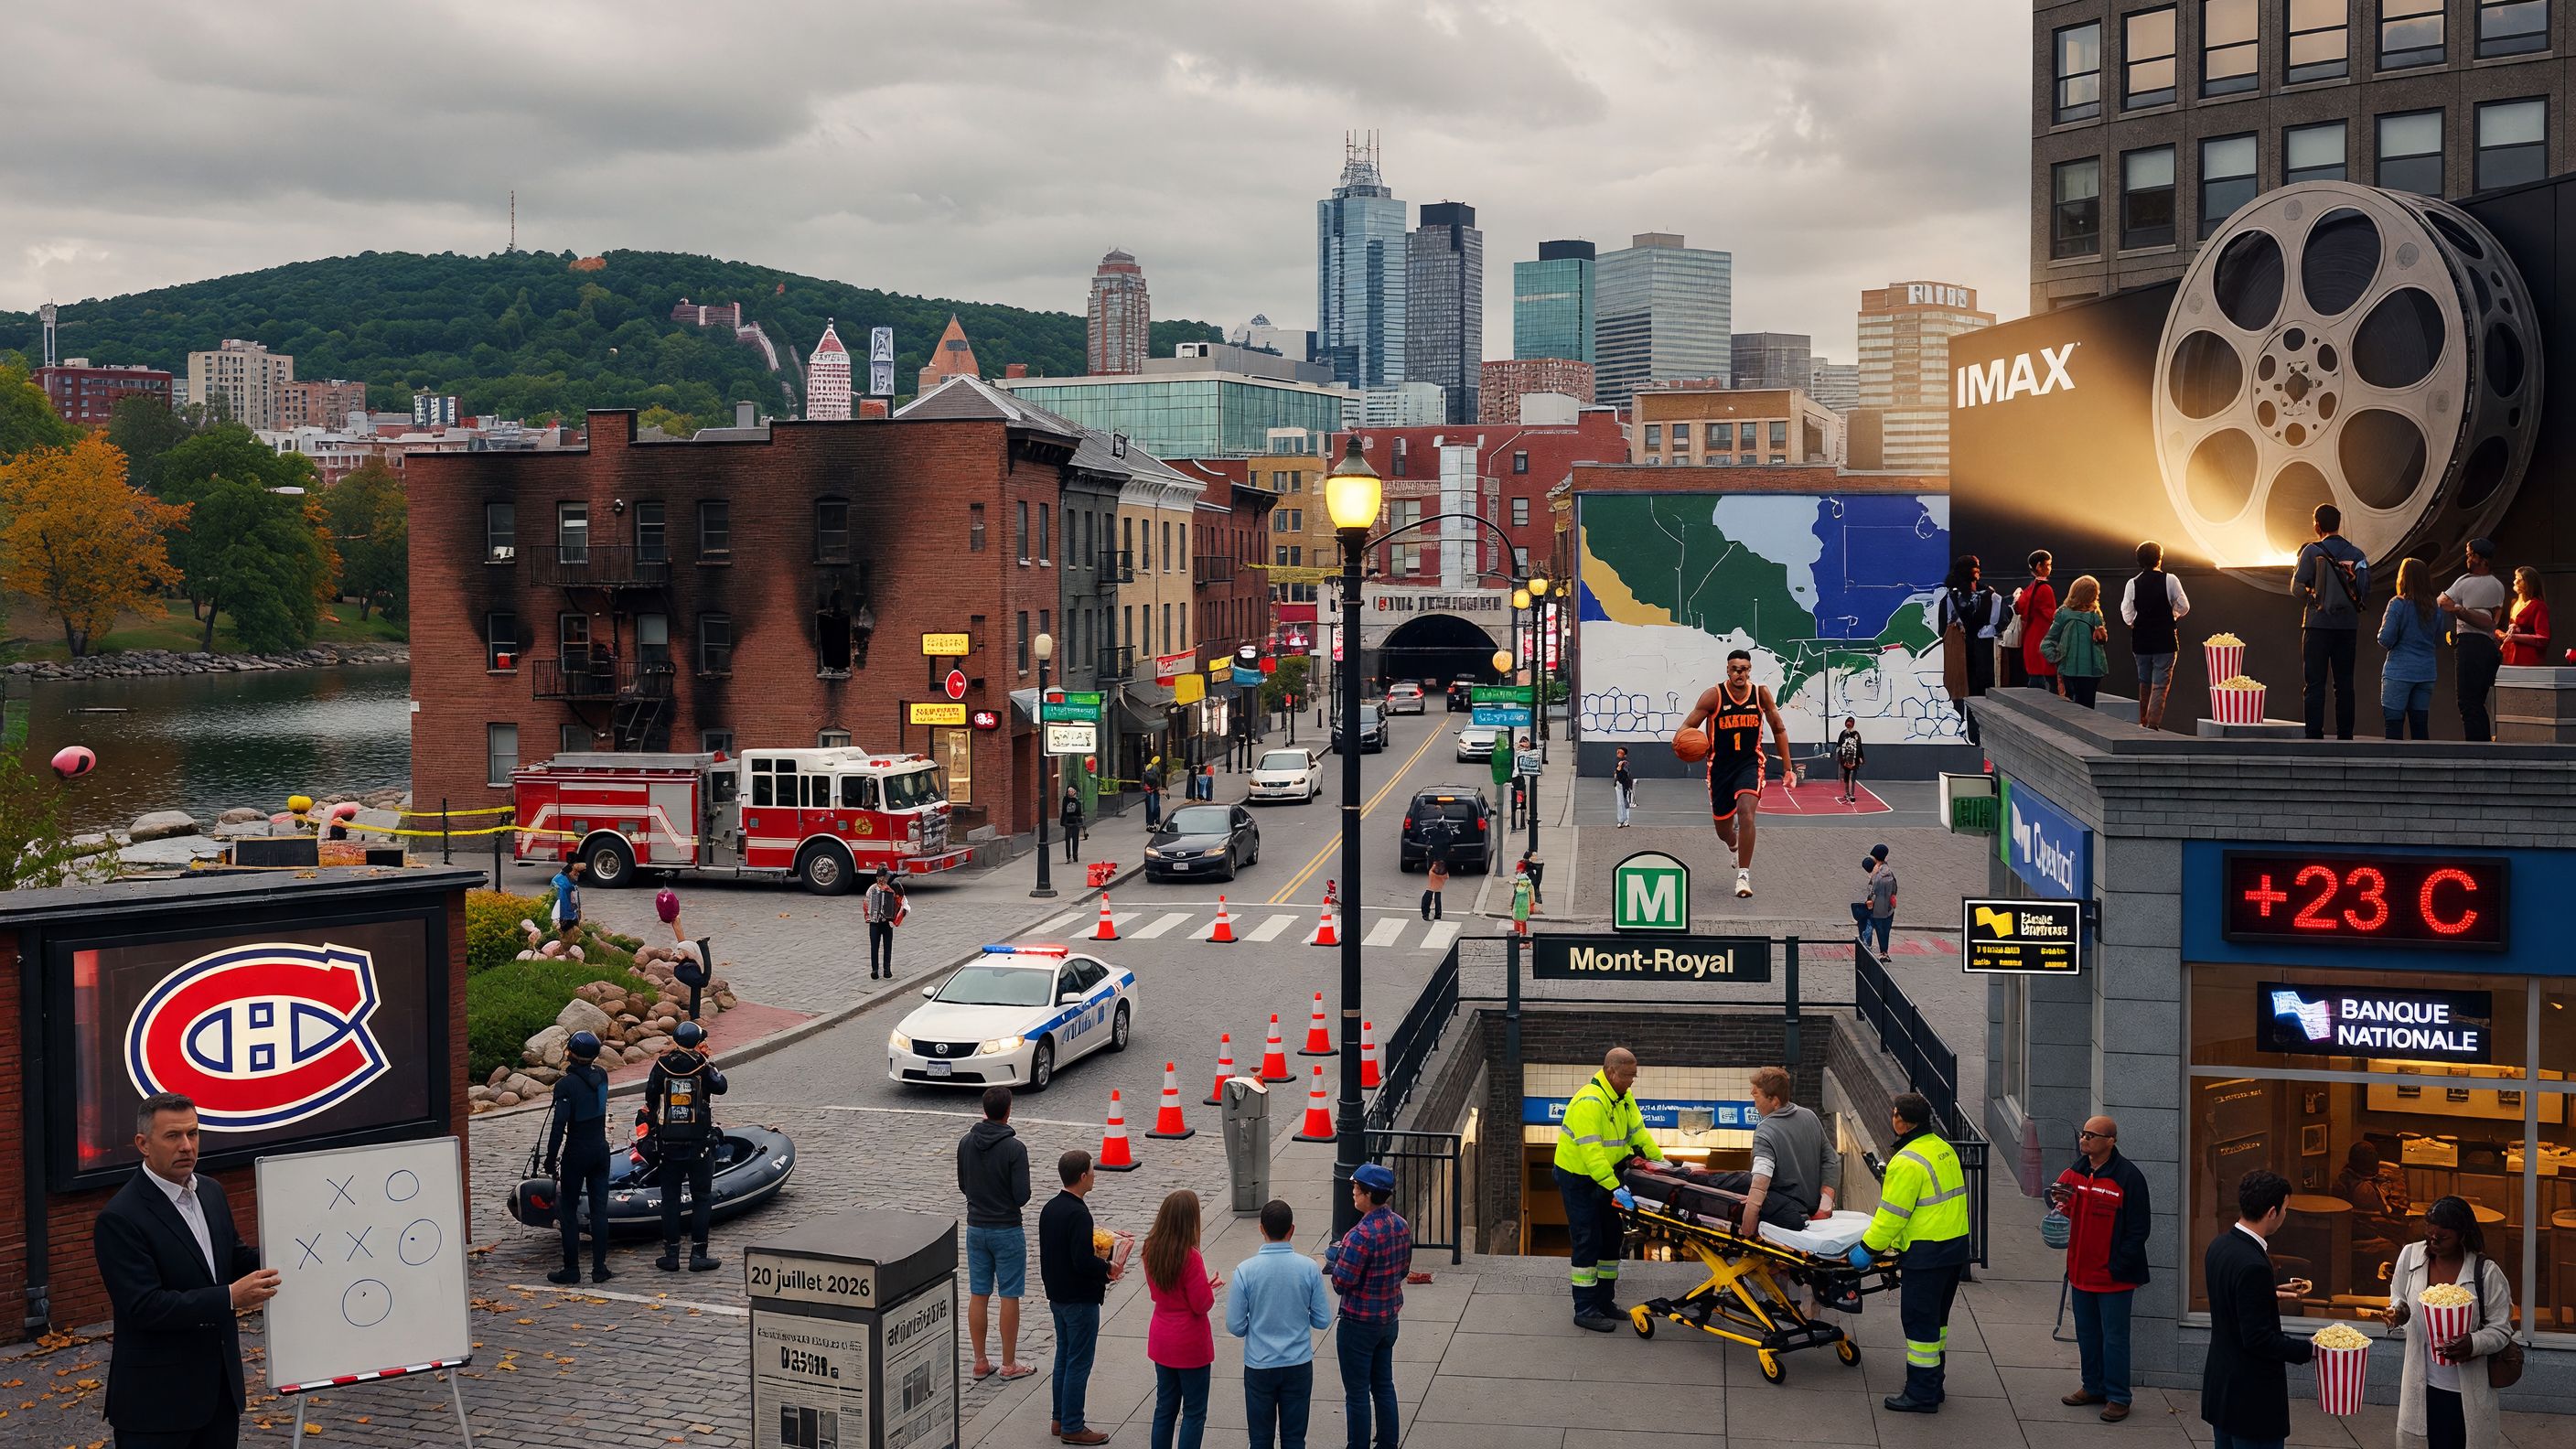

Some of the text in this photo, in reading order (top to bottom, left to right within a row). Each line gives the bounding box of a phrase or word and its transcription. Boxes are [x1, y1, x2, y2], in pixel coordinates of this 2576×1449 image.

[1958, 342, 2076, 409] IMAX
[1733, 732, 1741, 750] 1
[1626, 875, 1676, 922] M
[2420, 869, 2478, 934] C
[1570, 947, 1733, 978] Mont-Royal
[2340, 998, 2449, 1025] BANQUE
[2337, 1025, 2477, 1051] NATIONALE
[751, 1267, 870, 1297] 20 juillet 2026
